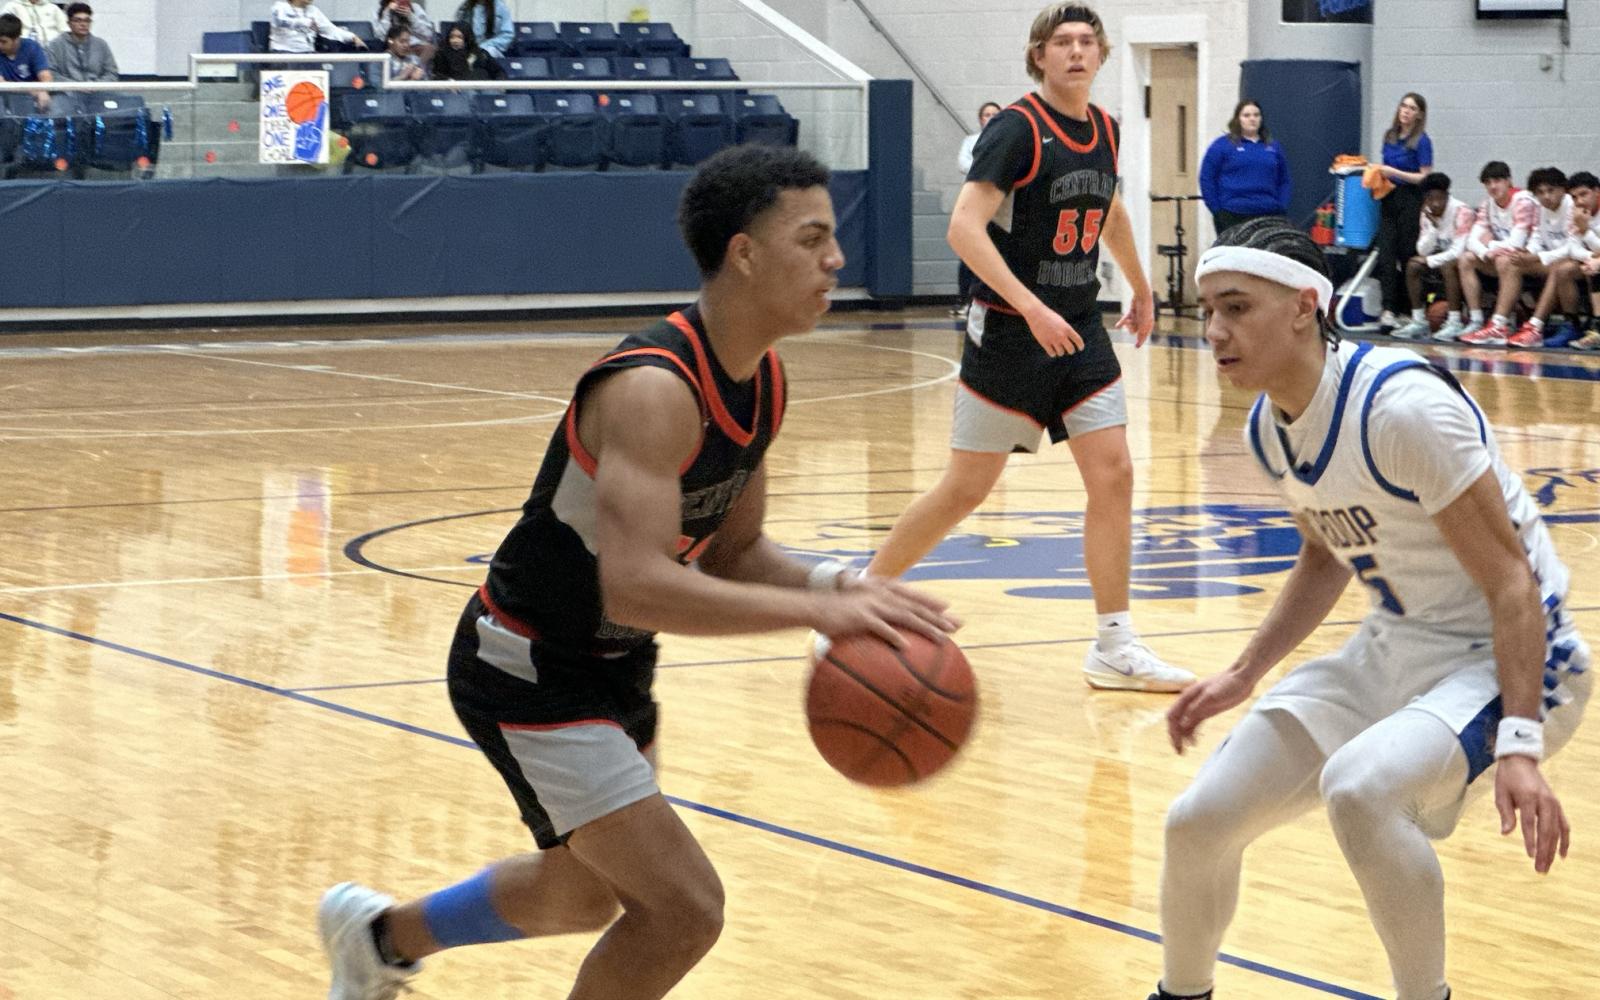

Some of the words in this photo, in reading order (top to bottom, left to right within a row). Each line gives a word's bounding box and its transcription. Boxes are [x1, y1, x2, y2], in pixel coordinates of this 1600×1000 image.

[263, 75, 287, 94] ONE
[263, 104, 288, 118] ONE
[263, 131, 291, 148] ONE
[1054, 209, 1103, 254] 55
[1350, 553, 1406, 617] 5
